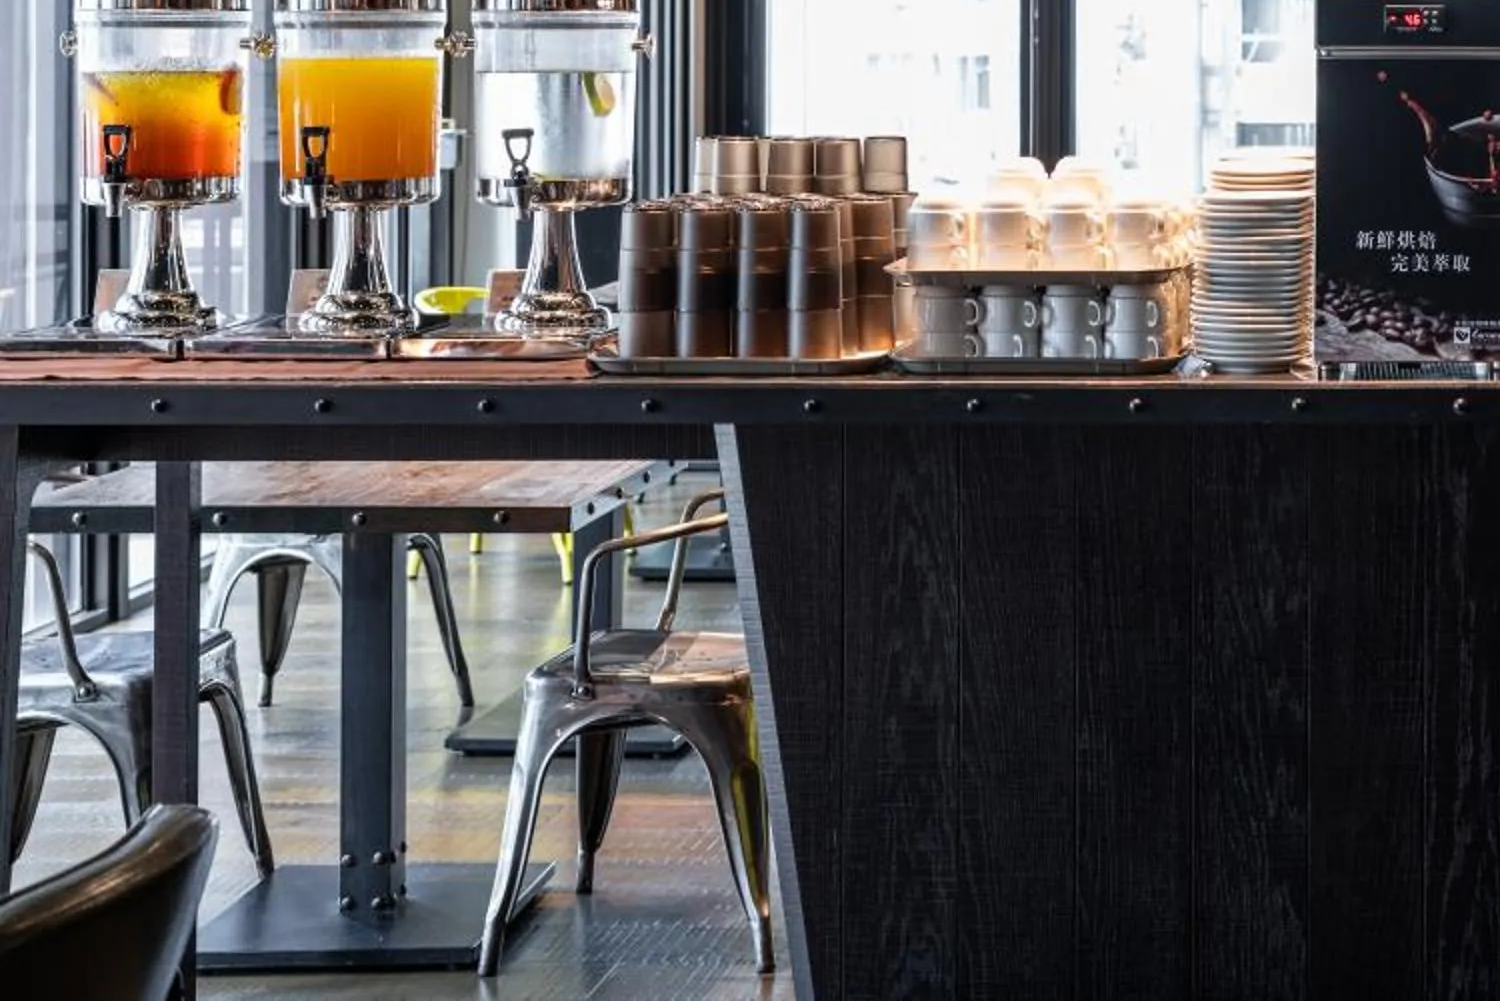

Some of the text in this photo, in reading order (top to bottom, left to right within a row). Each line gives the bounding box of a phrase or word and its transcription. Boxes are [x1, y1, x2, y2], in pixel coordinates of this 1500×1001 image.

[1356, 230, 1437, 250] 新鮮烘焙
[1391, 253, 1470, 272] 完美萃取
